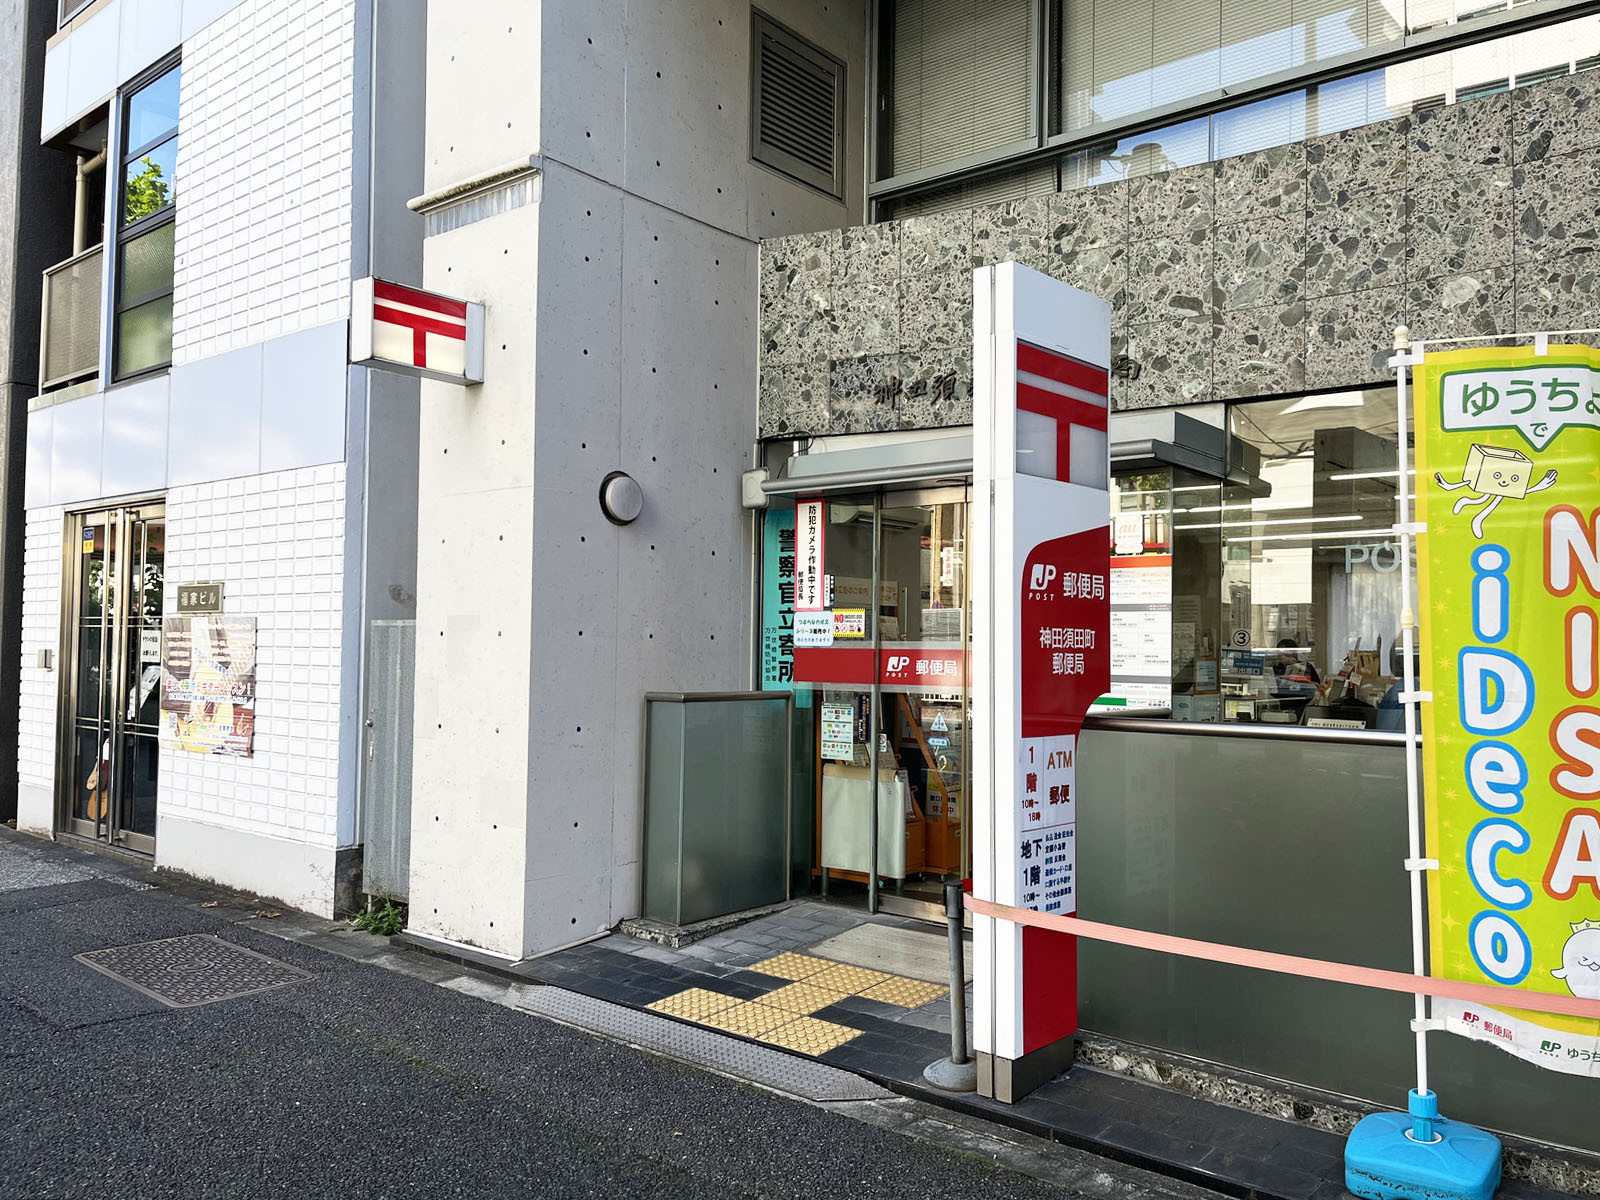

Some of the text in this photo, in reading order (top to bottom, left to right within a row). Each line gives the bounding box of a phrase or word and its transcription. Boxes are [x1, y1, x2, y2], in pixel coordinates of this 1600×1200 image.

[1530, 423, 1548, 438] で
[807, 504, 816, 605] 防犯カメラ作動中です
[1063, 571, 1105, 600] 郵便局
[778, 528, 795, 683] 警察官立寄所
[1028, 593, 1055, 601] POST
[834, 614, 844, 623] NO
[1039, 627, 1096, 650] 神田須田町
[915, 659, 958, 675] 郵便局
[1052, 652, 1085, 675] 郵便局
[1047, 750, 1072, 770] ATM
[1457, 544, 1535, 986] iDeCo
[1049, 784, 1070, 805] 郵便
[1021, 838, 1043, 860] 地下
[1023, 865, 1041, 887] 1階
[1483, 1021, 1513, 1041] 郵便局
